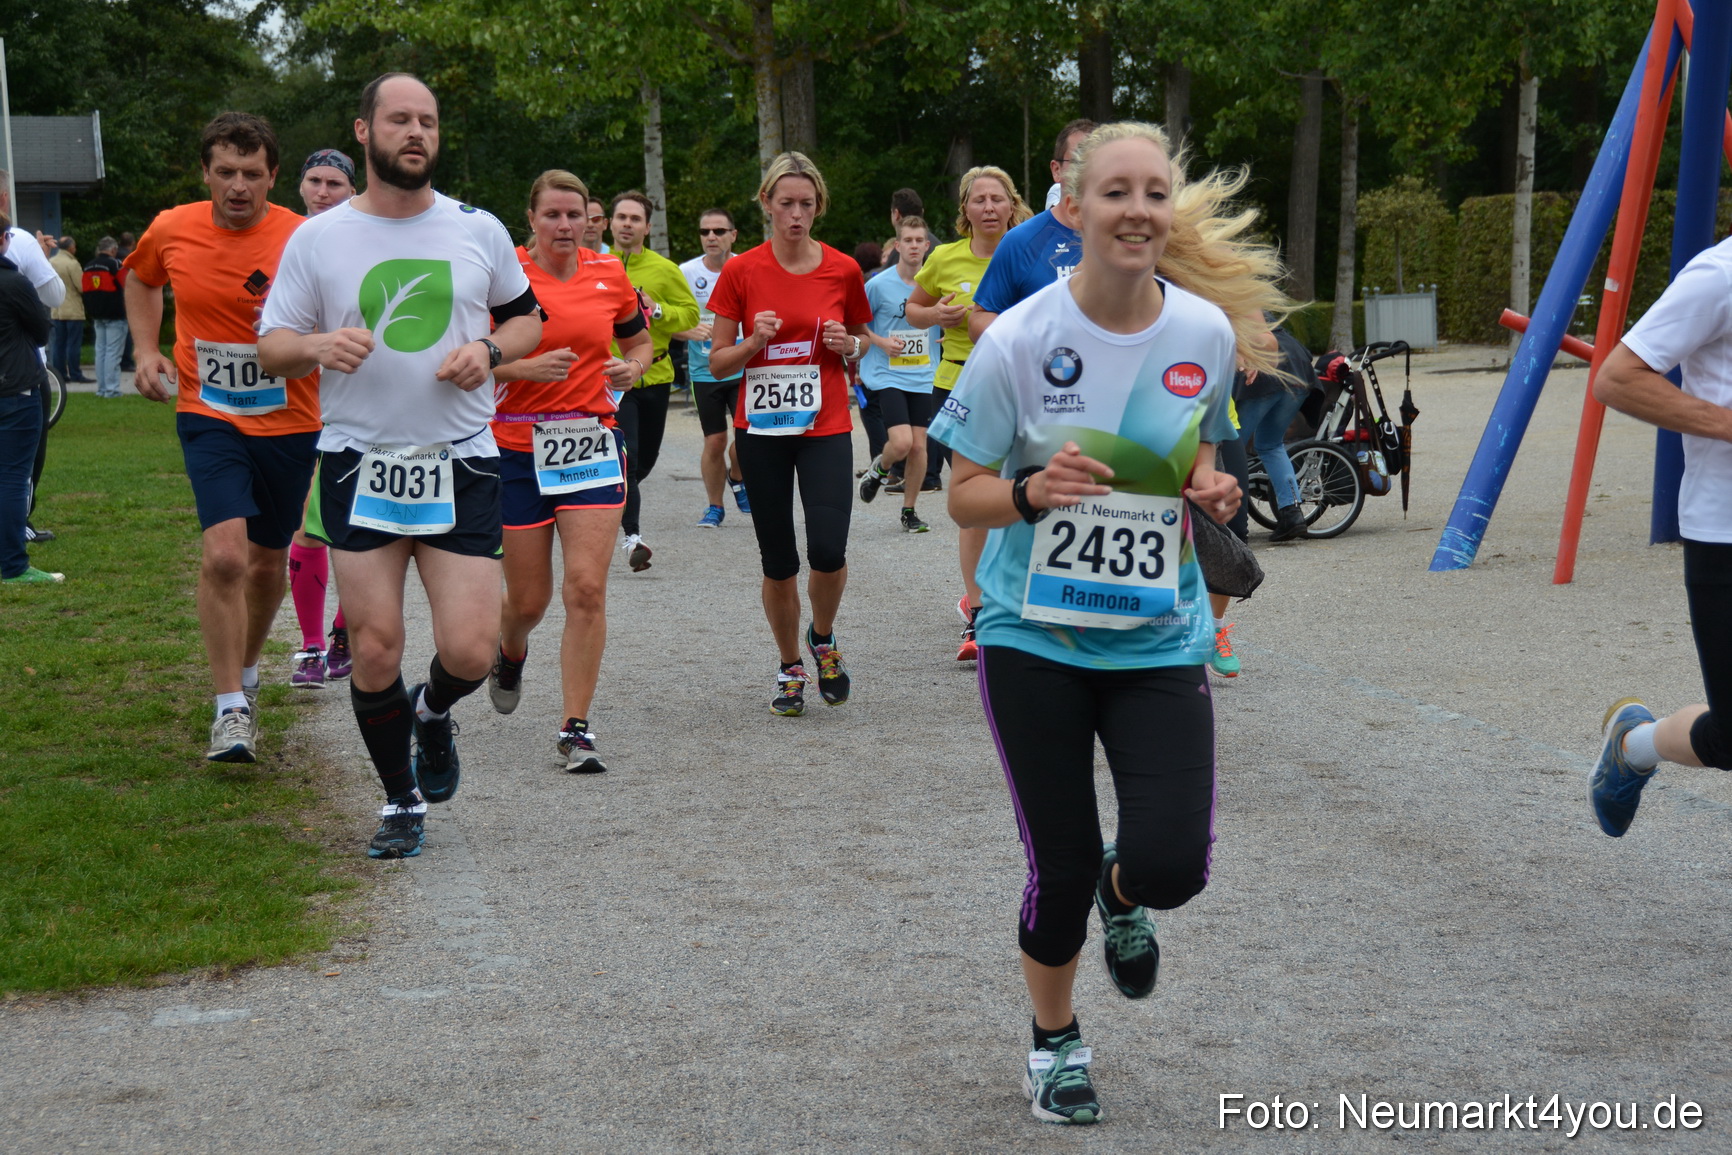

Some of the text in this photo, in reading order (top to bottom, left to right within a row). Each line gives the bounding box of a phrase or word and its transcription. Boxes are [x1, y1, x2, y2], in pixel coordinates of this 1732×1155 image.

[197, 346, 258, 359] PARTL Neuma
[779, 346, 799, 355] DEHN
[748, 372, 808, 382] PARTL Neumarkt
[1169, 371, 1202, 389] Hervis
[226, 393, 258, 406] Franz
[753, 382, 815, 410] 2548
[1043, 394, 1086, 406] PARTL
[505, 414, 536, 422] Powerfrau
[550, 411, 583, 420] Powerfrau
[1043, 406, 1086, 414] Neumarkt
[773, 415, 795, 426] Julia
[535, 424, 600, 436] PARTL Neumark
[369, 447, 395, 458] PARTL
[543, 433, 610, 467] 2224
[369, 459, 441, 499] 3031
[559, 467, 600, 483] Annette
[375, 500, 418, 520] JAN
[1092, 504, 1155, 522] Neumarkt
[1046, 520, 1165, 580] 2433
[1061, 584, 1141, 612] Ramona
